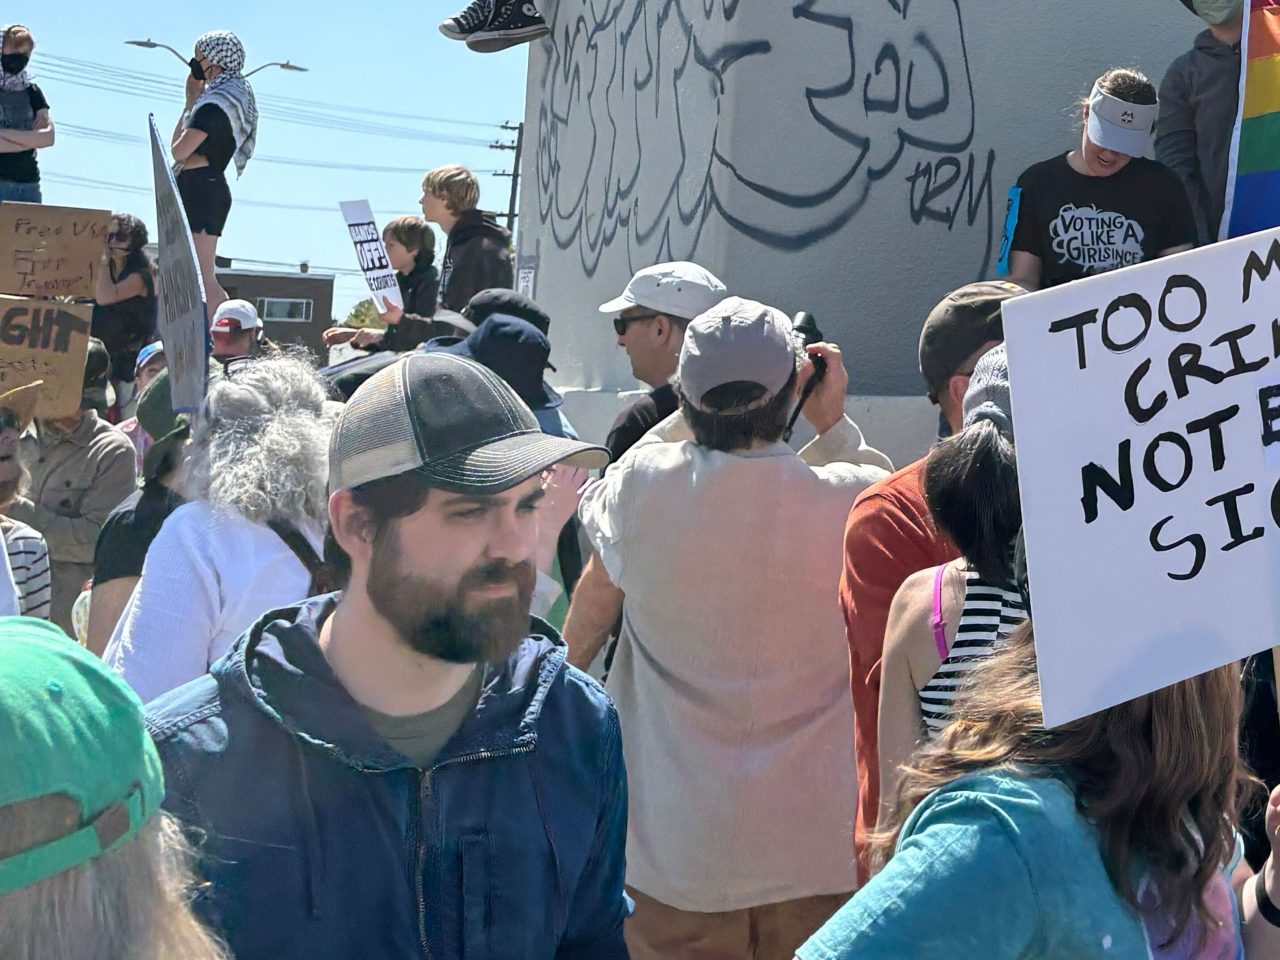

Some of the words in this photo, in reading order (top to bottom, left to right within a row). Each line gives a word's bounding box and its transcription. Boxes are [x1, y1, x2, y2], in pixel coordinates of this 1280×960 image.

[1060, 214, 1124, 235] VOTING
[1080, 229, 1116, 247] LIKE
[1122, 222, 1140, 245] A
[1066, 236, 1106, 263] GIRL
[1048, 274, 1207, 370] TOO
[1081, 404, 1240, 524] NOT
